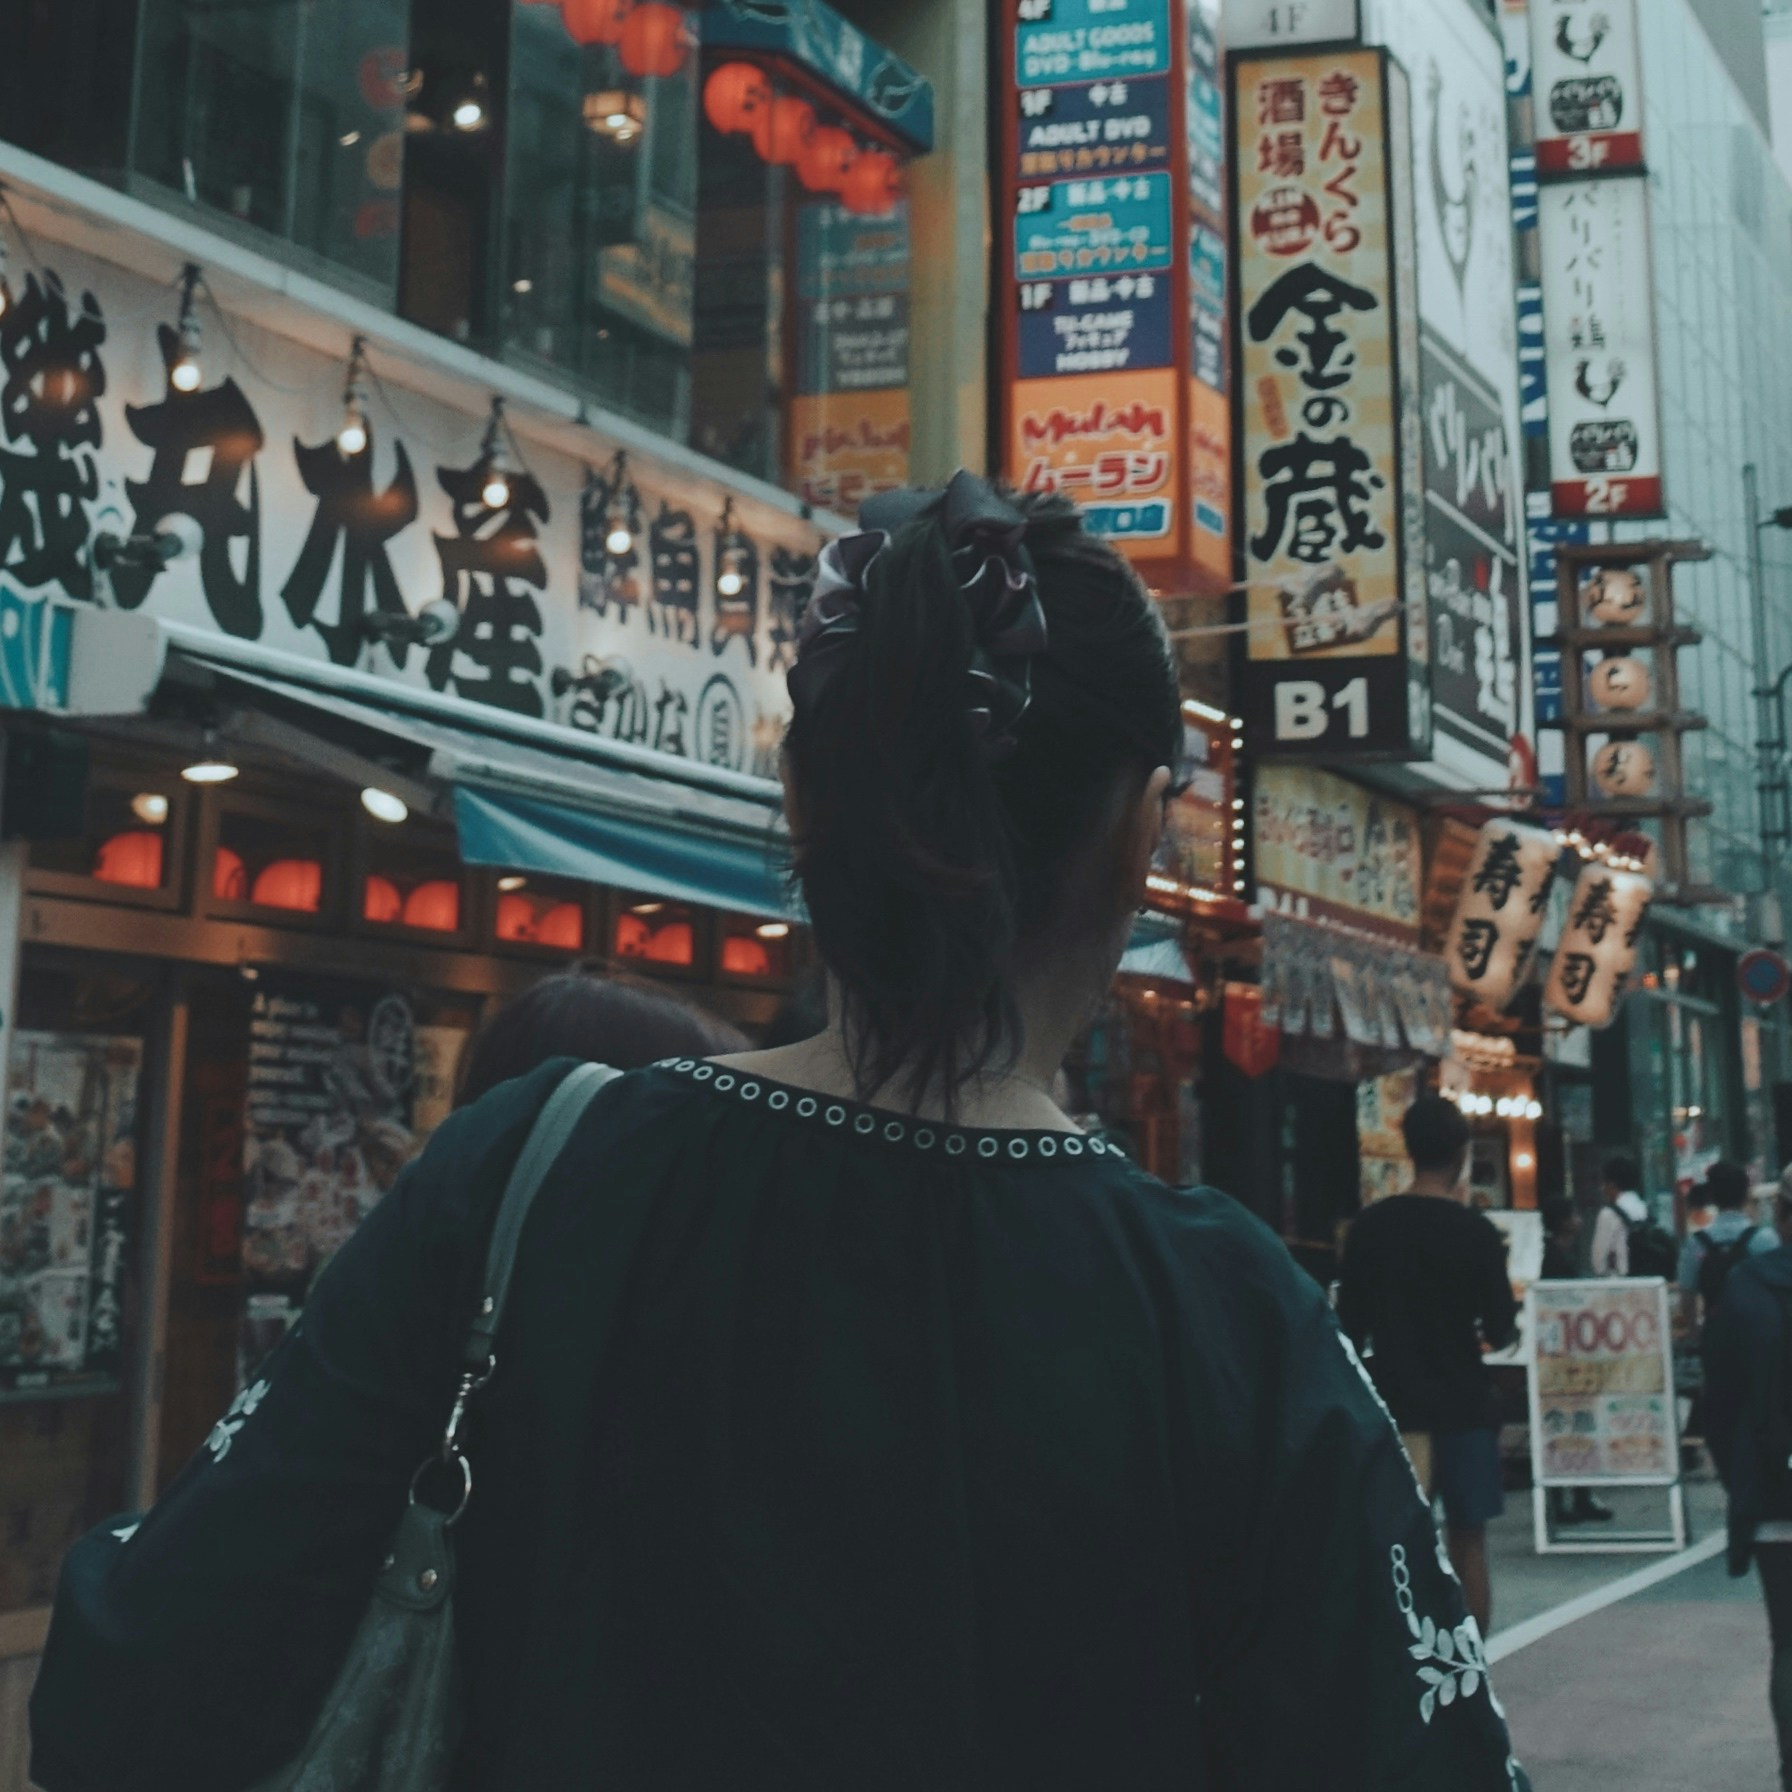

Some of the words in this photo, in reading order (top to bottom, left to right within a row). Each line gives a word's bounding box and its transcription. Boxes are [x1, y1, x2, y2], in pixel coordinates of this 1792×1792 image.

[1022, 27, 1088, 56] ADULT
[1028, 119, 1099, 148] ADULT
[1104, 115, 1152, 141] DVD
[1258, 77, 1307, 180] 酒場
[1315, 71, 1364, 256] きんくら
[1566, 136, 1611, 171] 3F
[1020, 282, 1053, 310] 1F
[1583, 477, 1631, 513] 2F
[1272, 675, 1371, 741] B1
